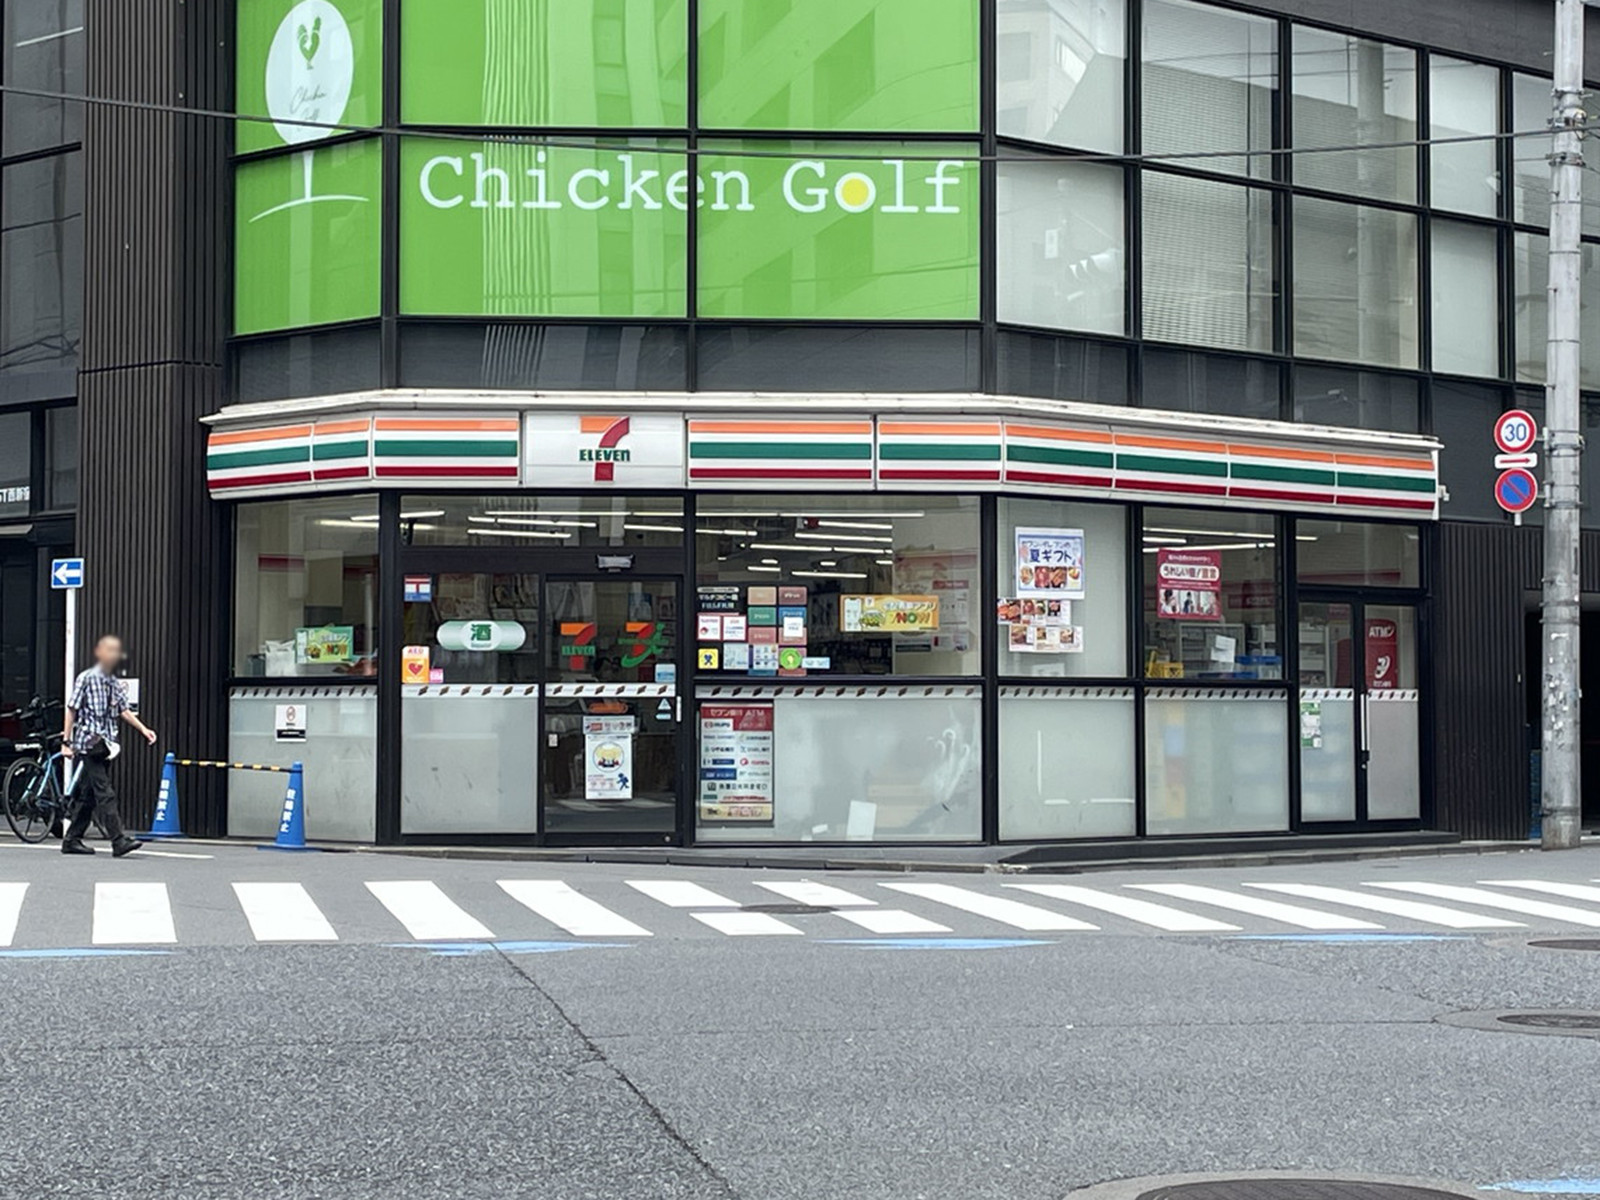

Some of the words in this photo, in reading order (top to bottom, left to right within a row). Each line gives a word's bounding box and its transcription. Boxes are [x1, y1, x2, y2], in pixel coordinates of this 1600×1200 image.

[419, 150, 756, 212] Chicken
[782, 159, 965, 214] Golf
[1505, 423, 1527, 442] 30
[1029, 549, 1073, 563] 夏ギフト
[470, 623, 492, 641] 酒
[1369, 626, 1388, 638] ATM
[408, 647, 424, 655] AED
